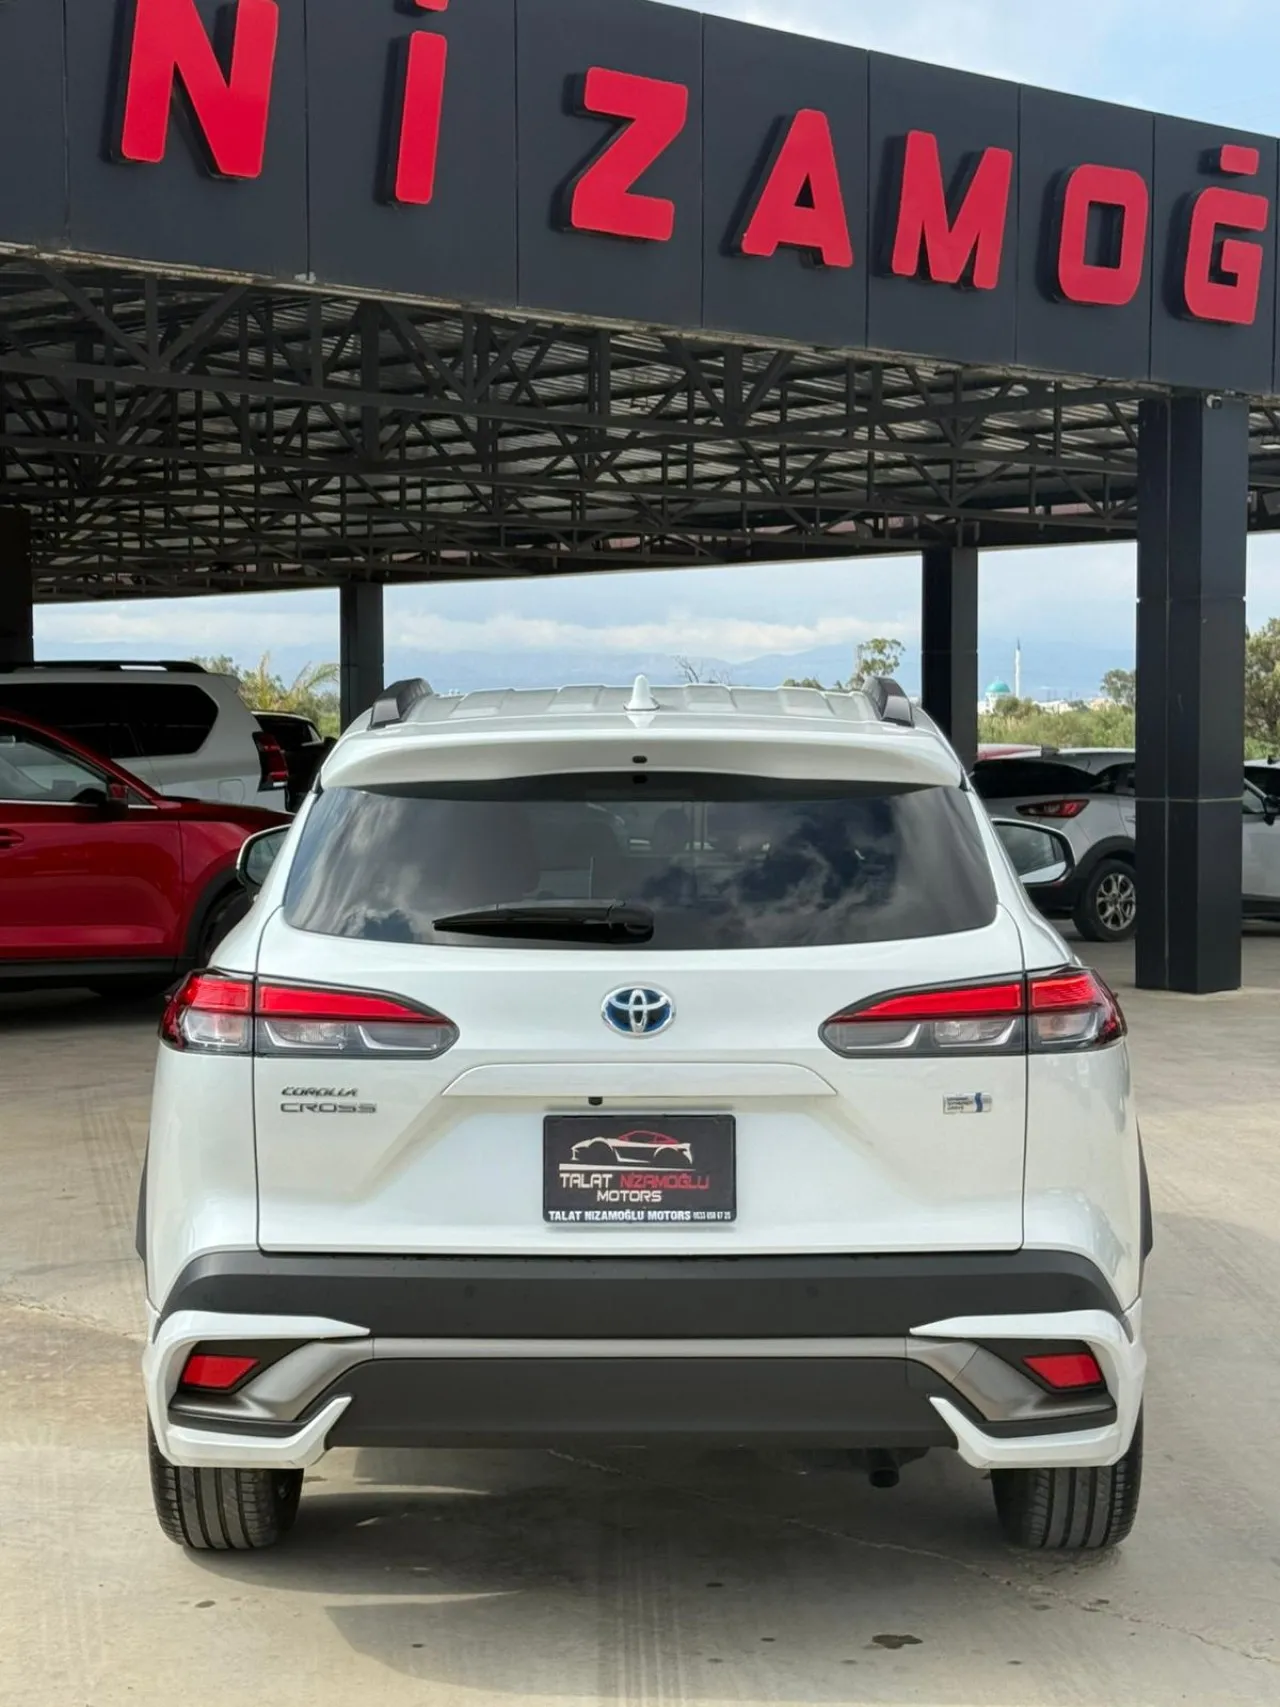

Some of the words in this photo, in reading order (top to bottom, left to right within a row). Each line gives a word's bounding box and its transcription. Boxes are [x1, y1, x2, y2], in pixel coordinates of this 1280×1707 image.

[281, 1085, 358, 1097] COROLLA
[280, 1102, 377, 1113] CROSS
[559, 1173, 613, 1189] TALAT
[596, 1190, 663, 1203] MOTORS
[548, 1210, 583, 1221] TALAT
[647, 1210, 691, 1221] MOTORS
